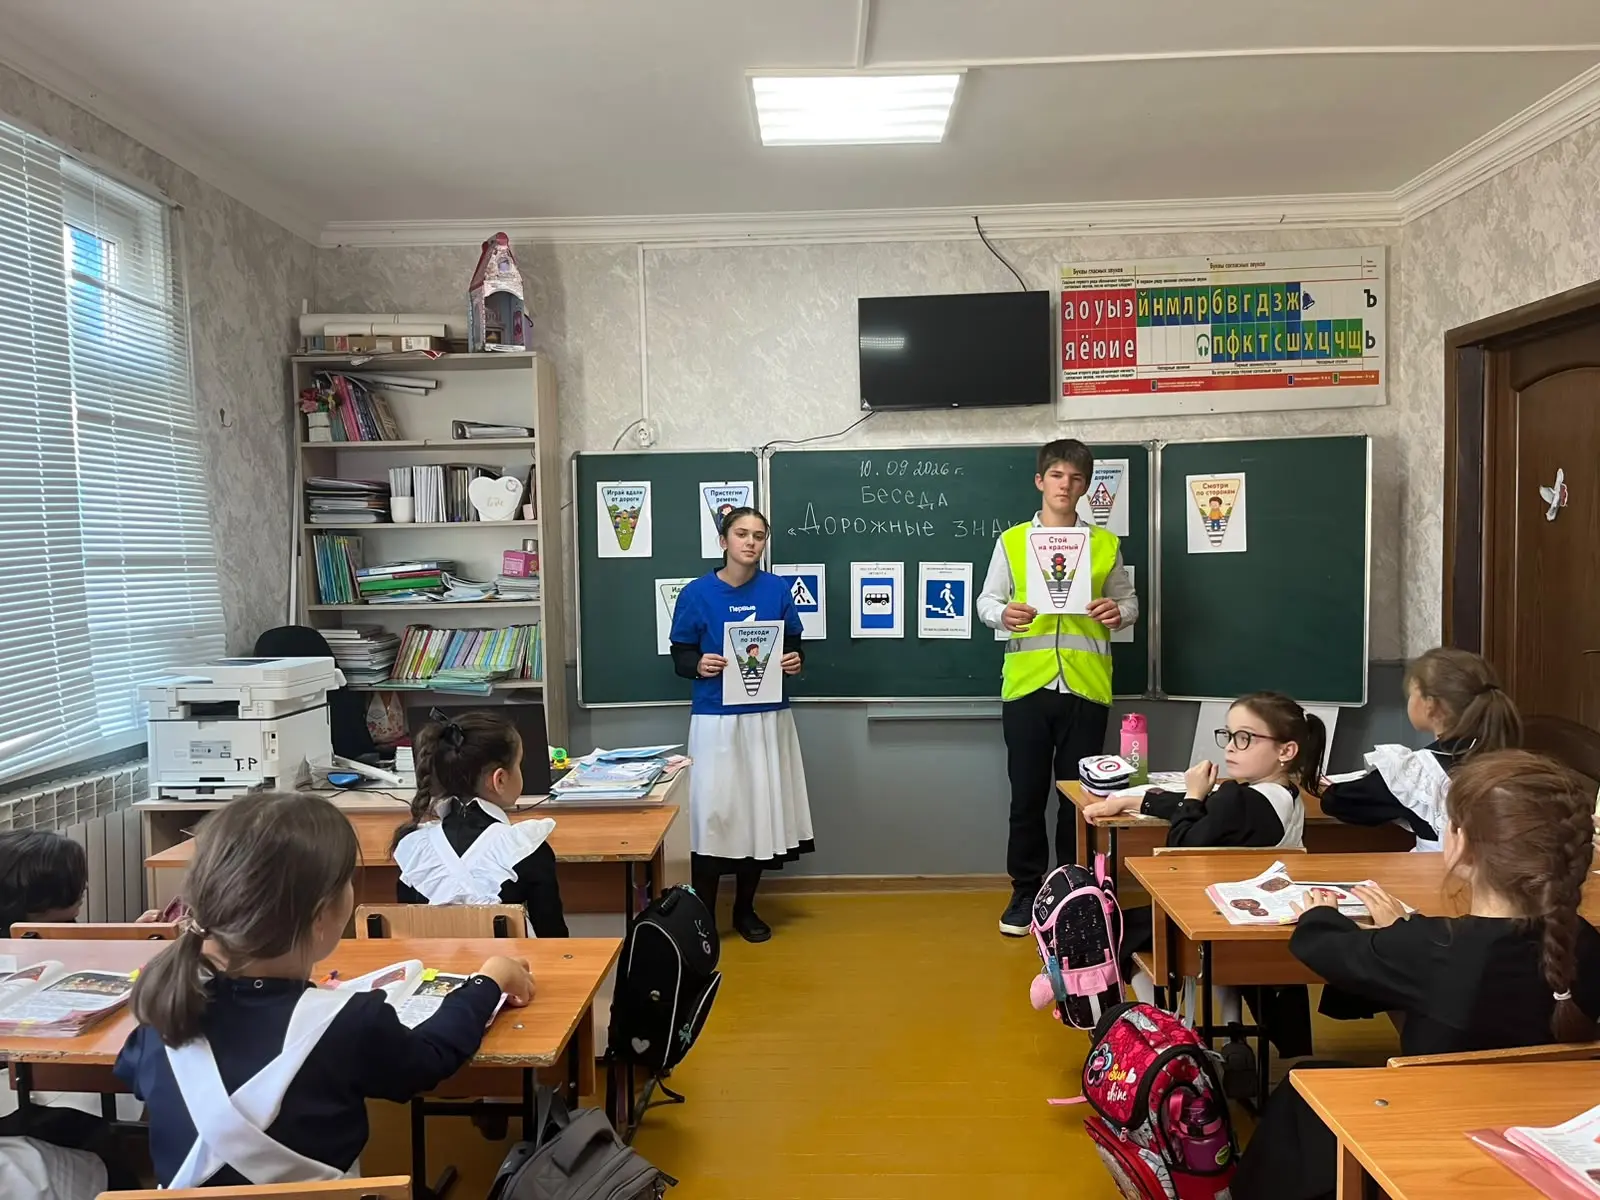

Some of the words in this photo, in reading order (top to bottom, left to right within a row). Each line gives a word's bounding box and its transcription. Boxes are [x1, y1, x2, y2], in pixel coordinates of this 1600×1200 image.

[607, 488, 625, 497] Играй
[710, 489, 742, 498] Пристегни
[716, 496, 738, 504] ремень
[1048, 536, 1067, 544] Стой
[1049, 543, 1079, 551] красный
[729, 605, 756, 613] Первые
[738, 629, 770, 637] Переходи
[1107, 1063, 1127, 1081] Sun
